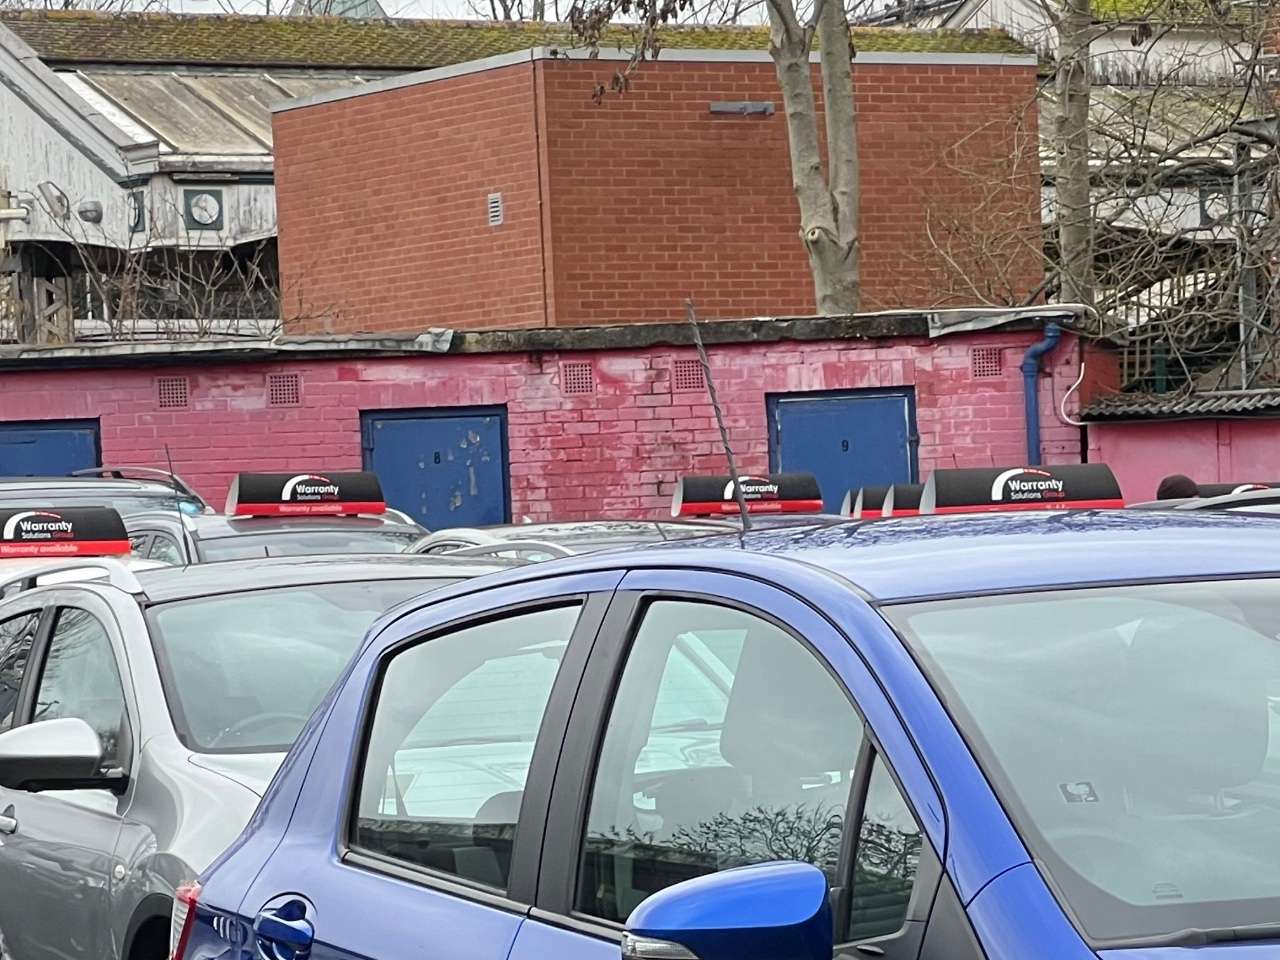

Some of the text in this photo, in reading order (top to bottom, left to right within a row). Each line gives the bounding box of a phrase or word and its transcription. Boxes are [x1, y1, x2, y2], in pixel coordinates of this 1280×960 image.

[296, 484, 339, 496] Warranty
[1008, 479, 1063, 491] Warranty
[20, 520, 72, 532] Warranty
